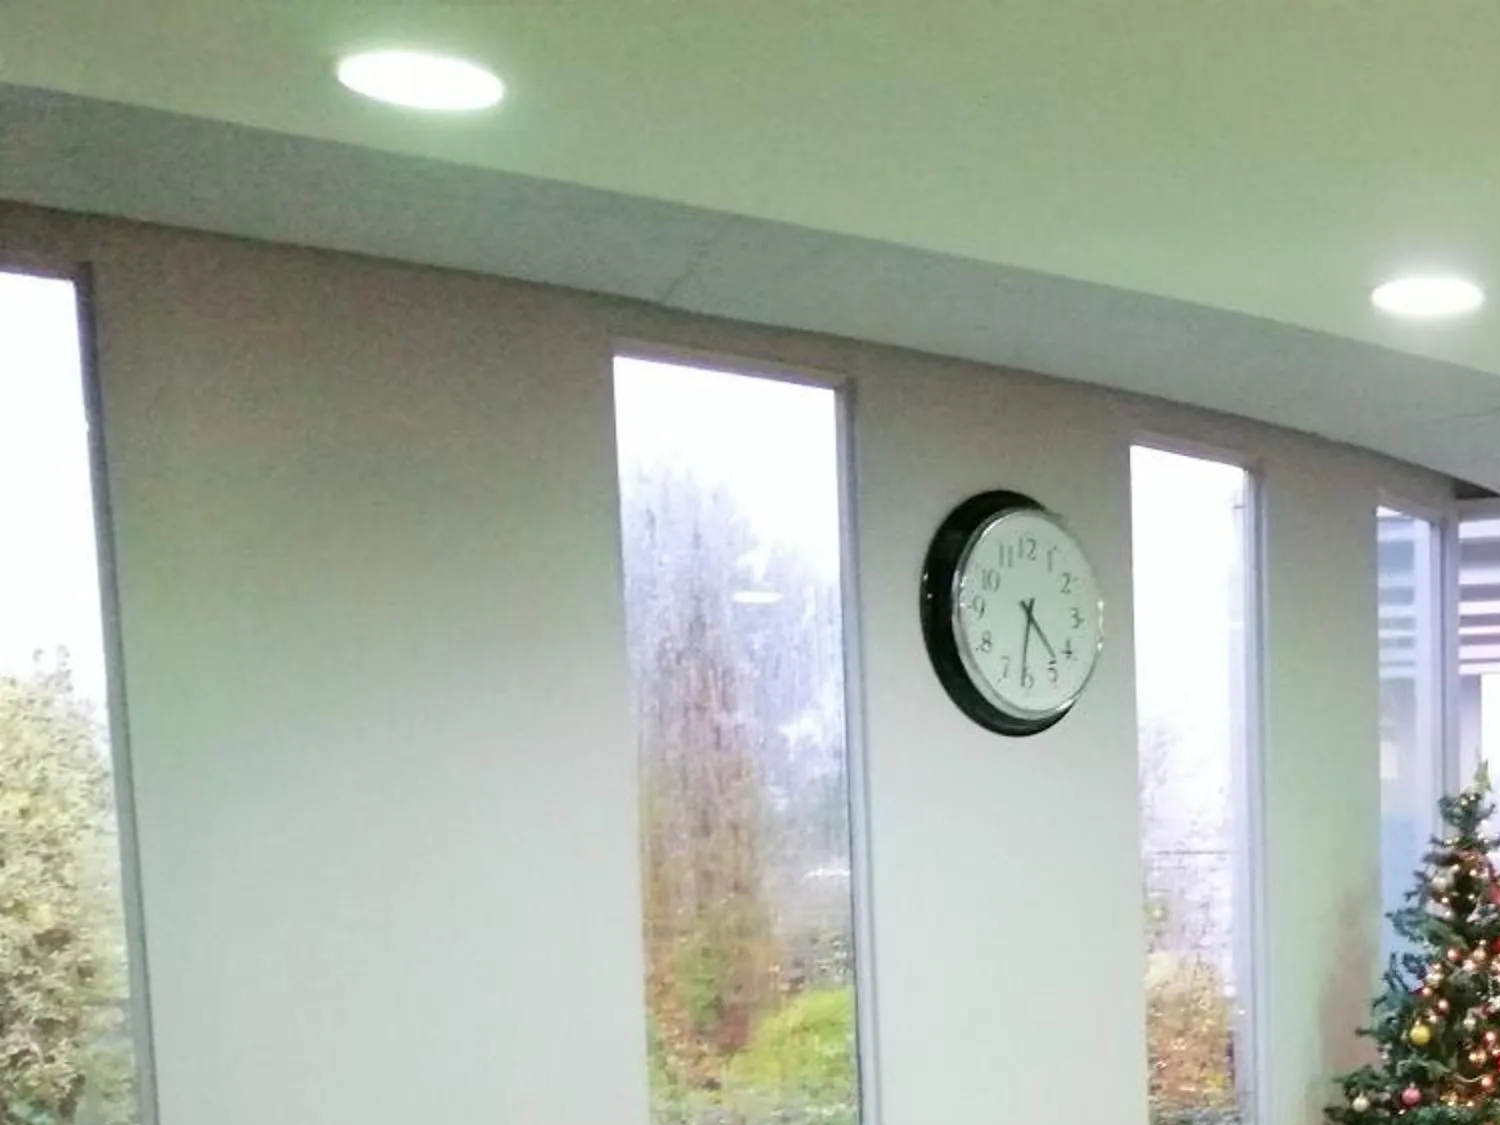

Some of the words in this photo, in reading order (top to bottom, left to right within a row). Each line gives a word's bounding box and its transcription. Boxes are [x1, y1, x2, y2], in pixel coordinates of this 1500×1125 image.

[999, 544, 1014, 568] 11
[1018, 537, 1036, 561] 12
[1048, 545, 1057, 571] 1
[982, 568, 1001, 594] 10
[1060, 572, 1072, 594] 2
[972, 595, 985, 619] 9
[1071, 608, 1082, 629] 3
[980, 631, 993, 653] 8
[1061, 638, 1073, 659] 4
[1000, 655, 1011, 679] 7
